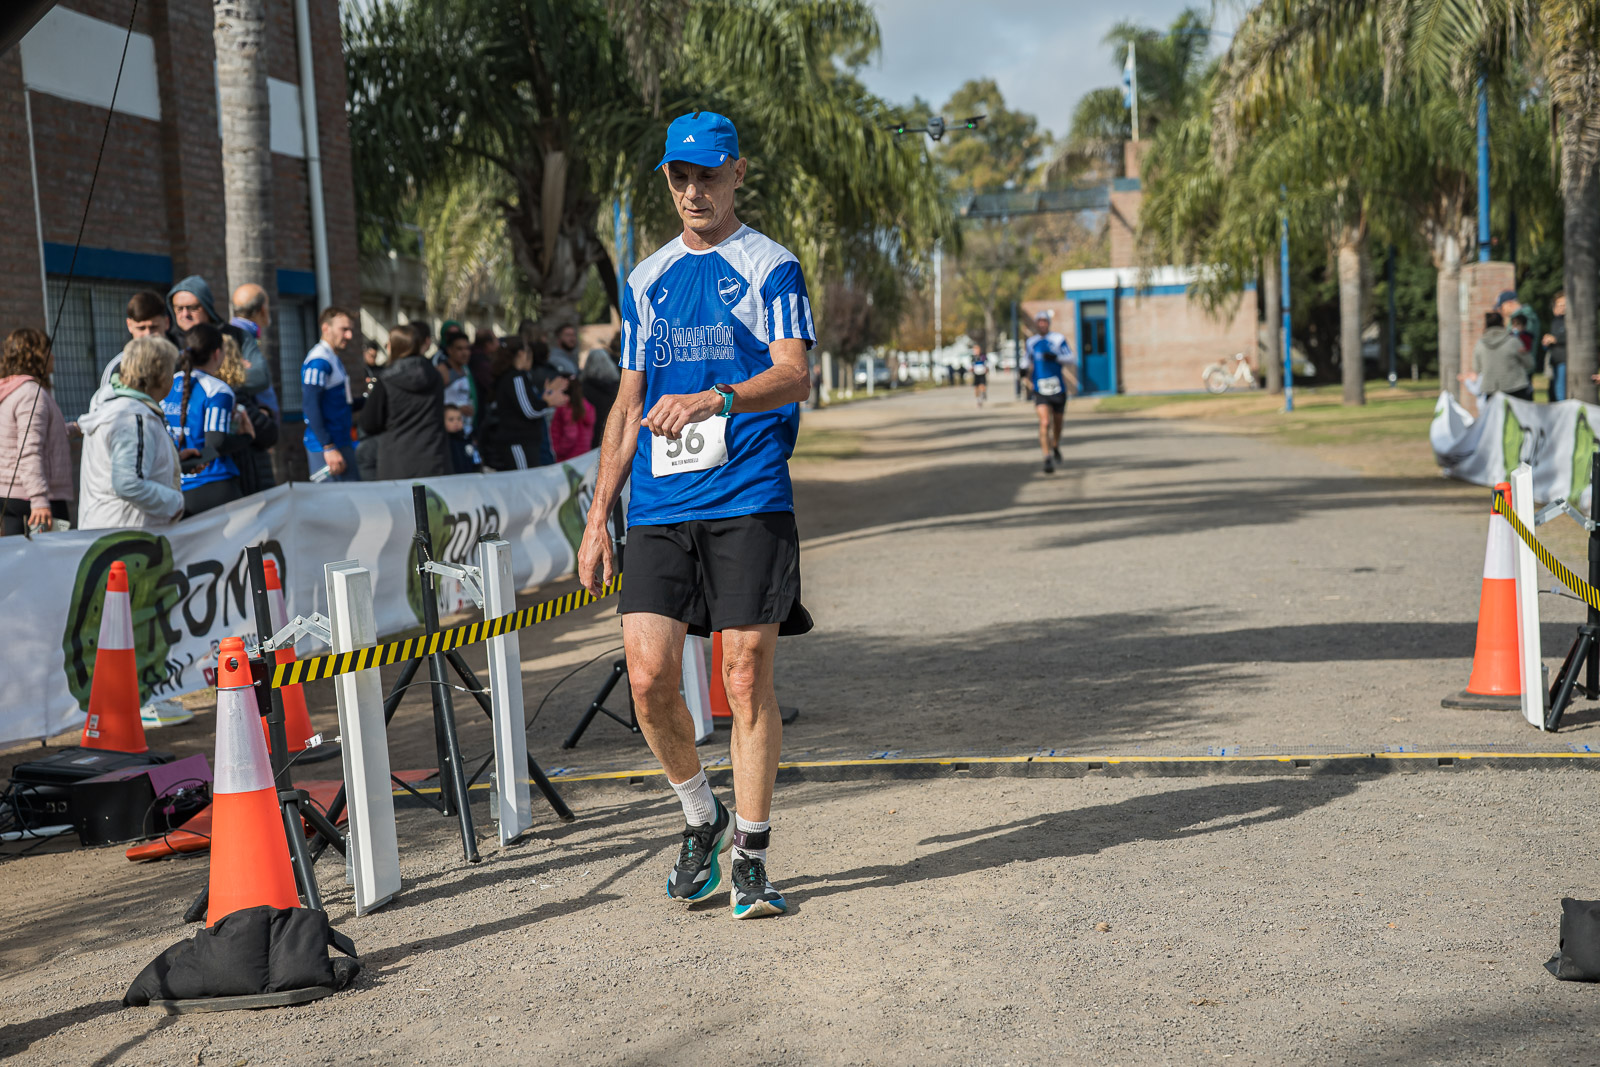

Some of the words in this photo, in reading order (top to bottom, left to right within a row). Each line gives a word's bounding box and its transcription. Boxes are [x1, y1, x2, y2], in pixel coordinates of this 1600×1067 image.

[653, 318, 672, 368] 3
[672, 322, 734, 348] MARATÓN
[674, 346, 735, 362] C.A.BEGRANO
